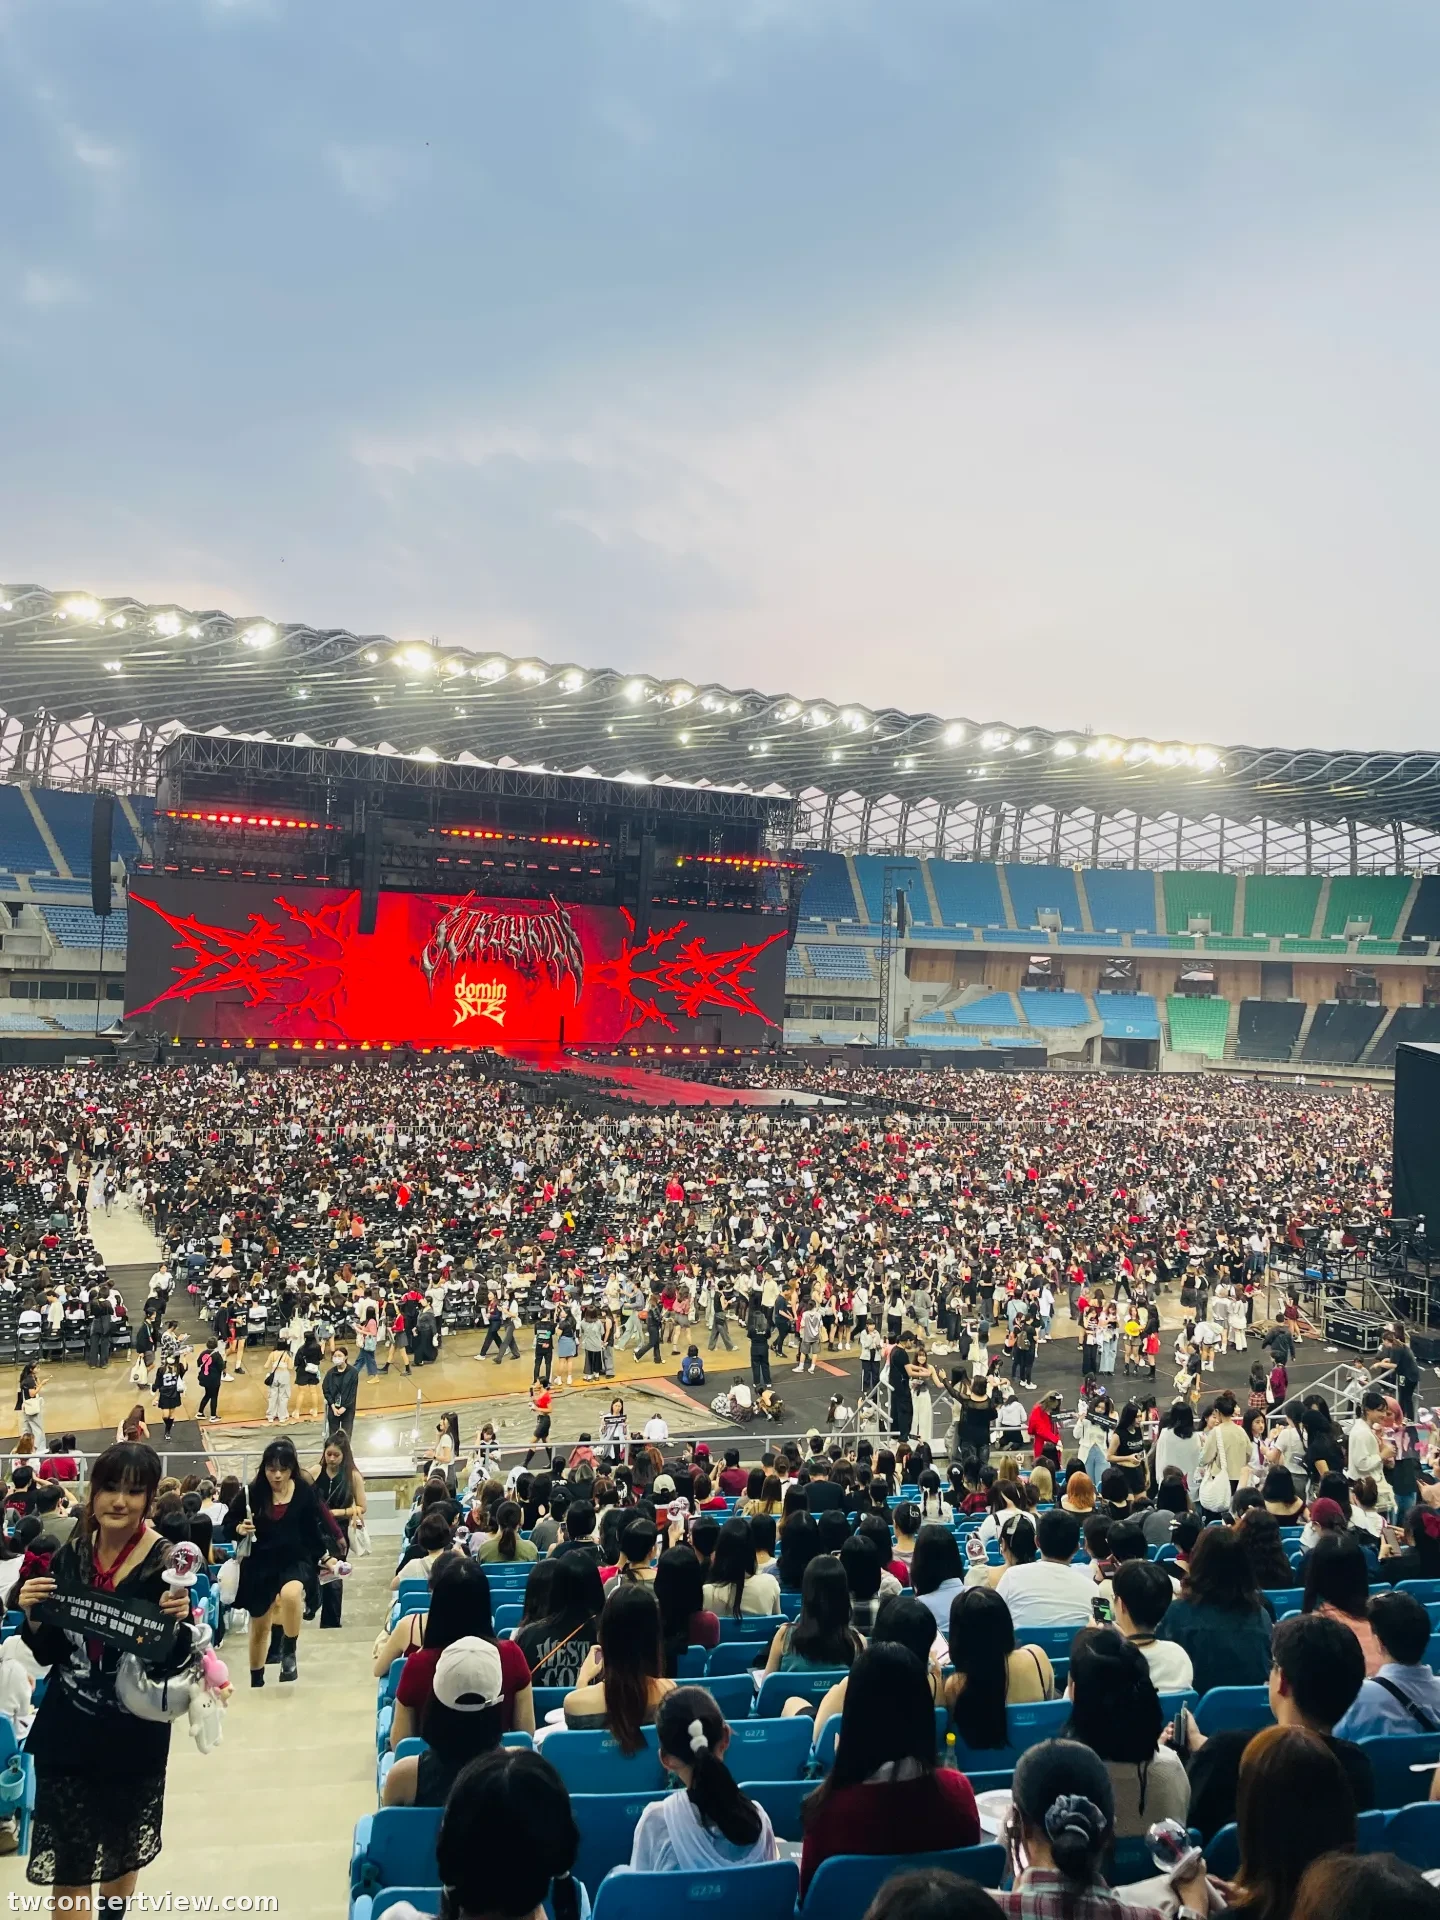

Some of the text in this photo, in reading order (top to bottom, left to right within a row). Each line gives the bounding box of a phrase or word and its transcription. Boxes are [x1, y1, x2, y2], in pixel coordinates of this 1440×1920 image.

[454, 973, 507, 999] domin
[90, 1612, 107, 1626] 너무
[536, 1637, 590, 1669] WEST
[541, 1666, 582, 1687] CO
[745, 1729, 765, 1737] G273
